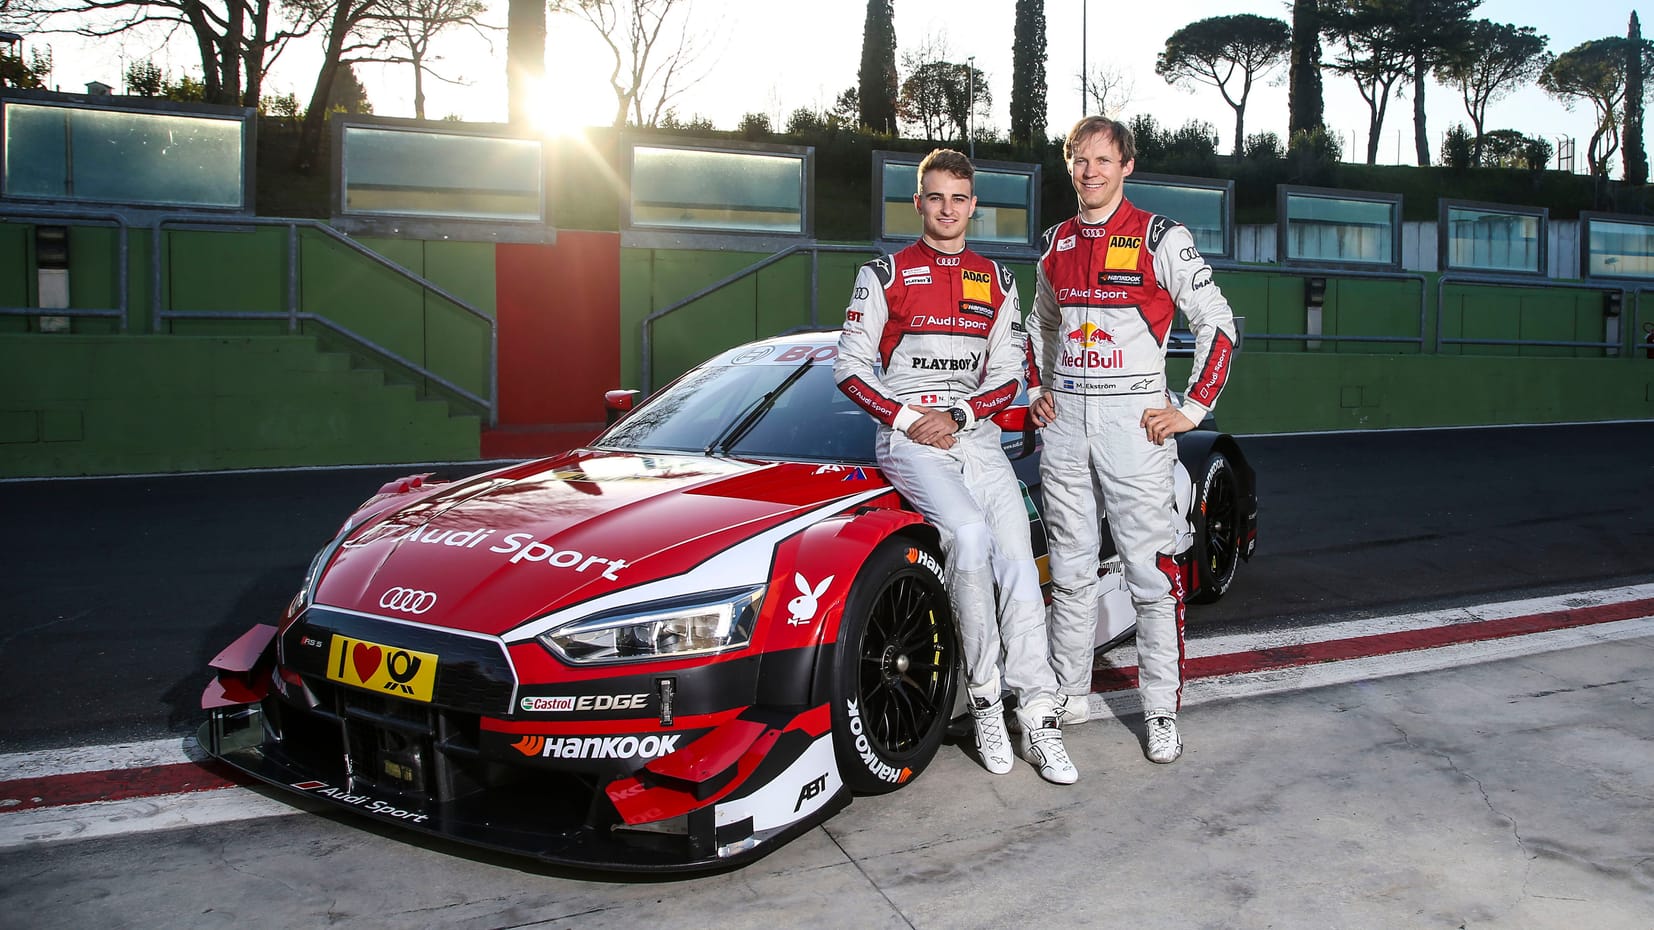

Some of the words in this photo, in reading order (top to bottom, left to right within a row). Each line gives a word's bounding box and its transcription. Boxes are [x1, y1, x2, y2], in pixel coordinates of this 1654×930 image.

[1110, 236, 1141, 249] ADAC
[962, 270, 990, 284] ADAC
[1069, 288, 1091, 298] Audi
[1094, 289, 1127, 299] Sport
[927, 316, 956, 327] Audi
[959, 317, 987, 330] Sport
[912, 357, 971, 371] PLAYBOY
[1061, 350, 1084, 368] Red
[1087, 350, 1123, 368] Bull
[1206, 373, 1219, 389] Audi
[1214, 349, 1227, 373] Sport
[856, 391, 870, 405] Audi
[871, 401, 893, 417] Sport
[995, 394, 1012, 407] Sport
[400, 524, 496, 549] Audi
[489, 533, 631, 581] Sport
[533, 697, 572, 710] Castrol
[575, 693, 650, 711] EDGE
[793, 772, 829, 813] ABT
[317, 788, 367, 806] Audi
[365, 800, 429, 823] Sport
